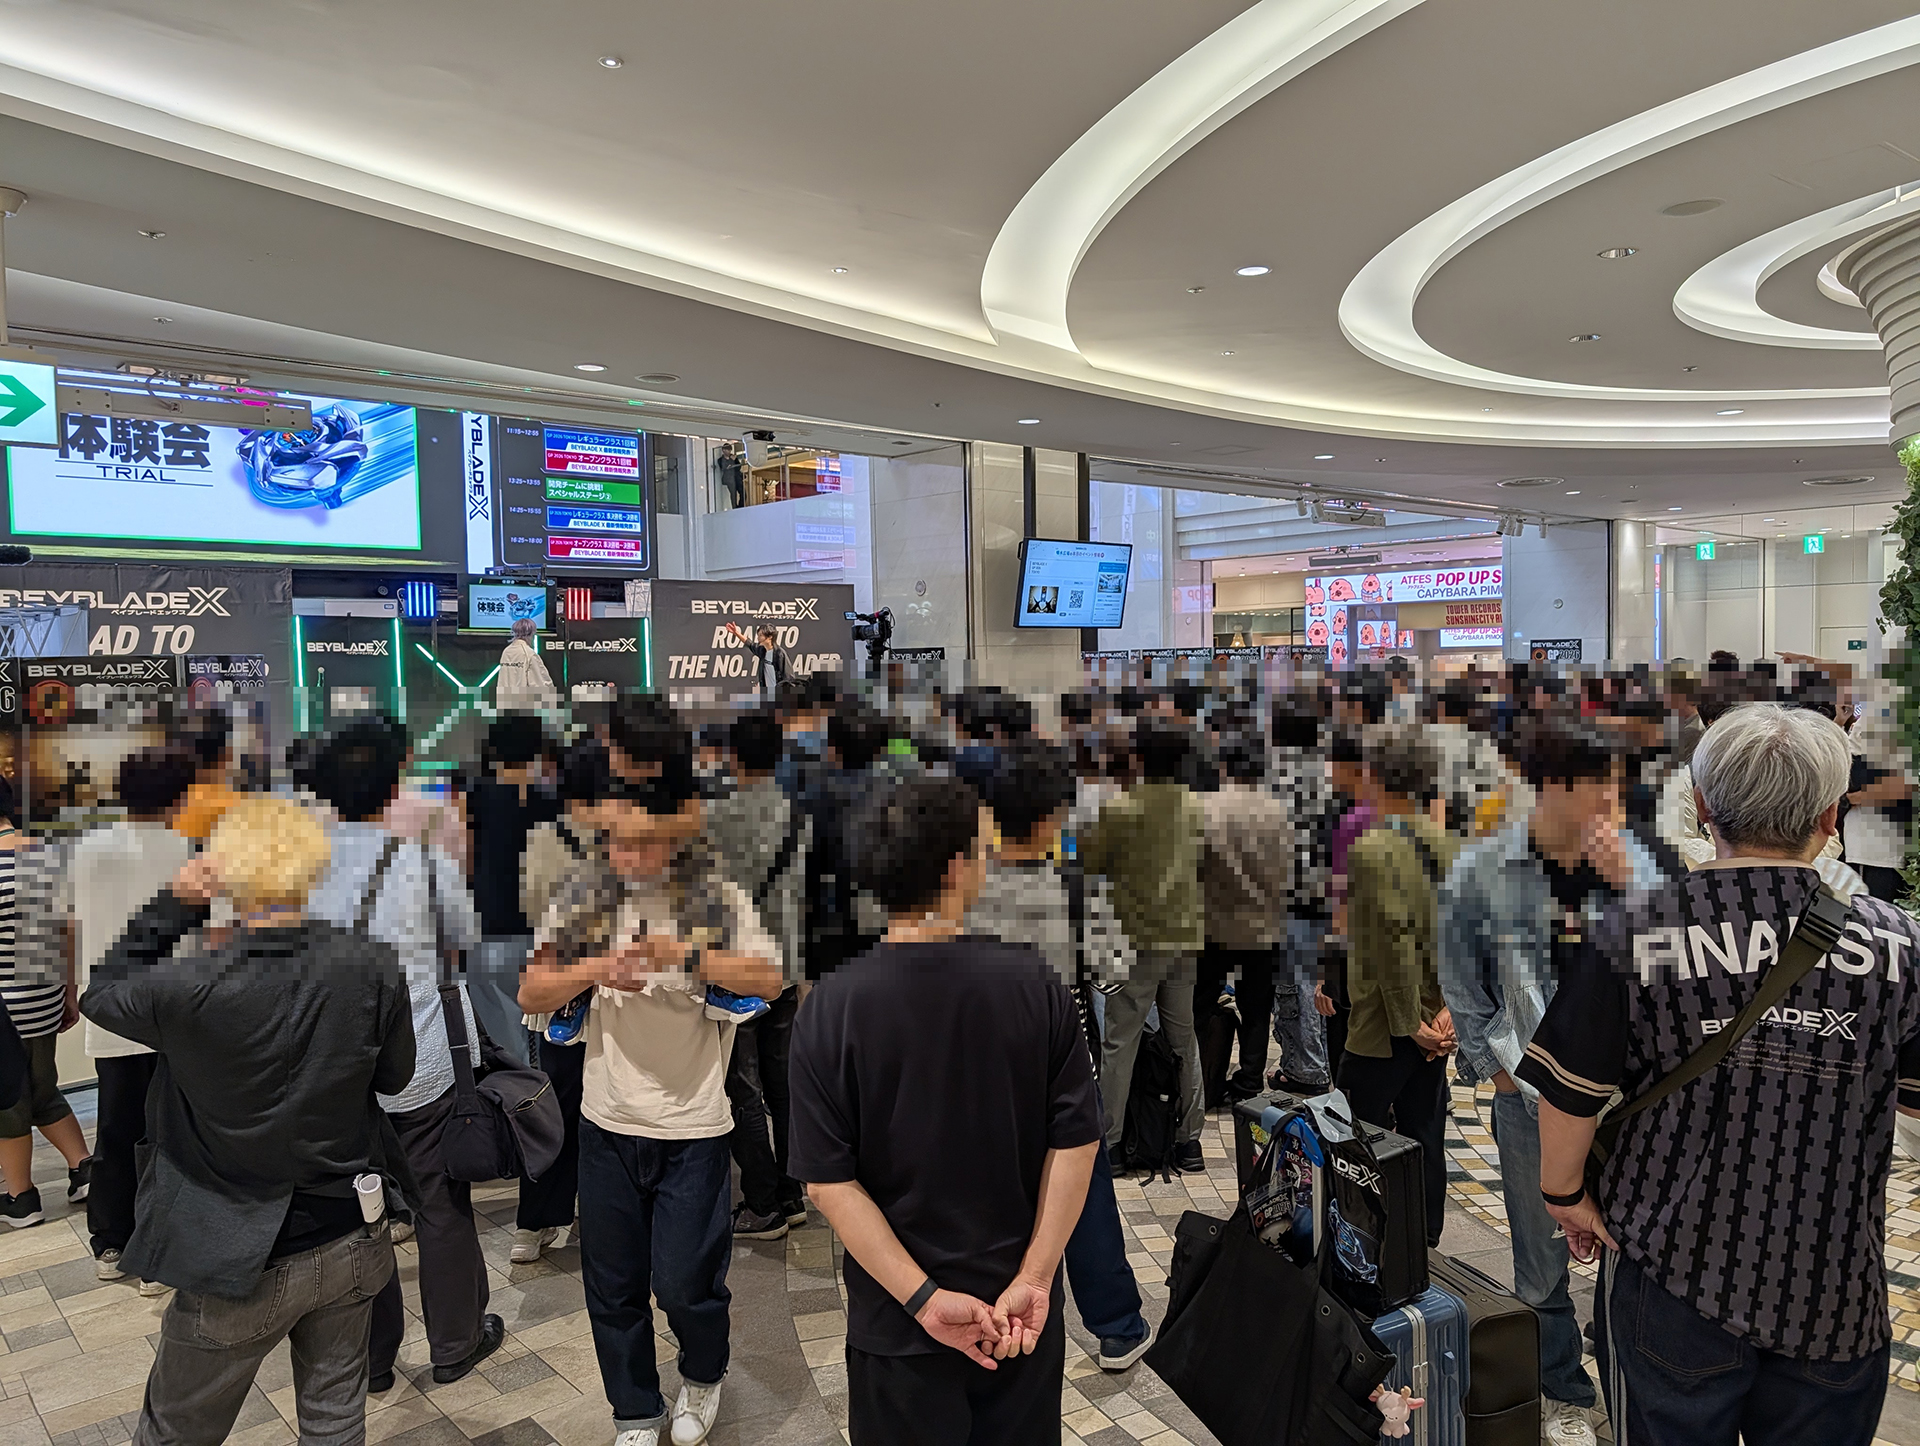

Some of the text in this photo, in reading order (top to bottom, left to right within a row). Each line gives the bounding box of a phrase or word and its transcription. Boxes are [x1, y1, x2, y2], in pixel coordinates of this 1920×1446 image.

[59, 413, 211, 468] 体験会
[96, 466, 176, 482] TRIAL
[1400, 574, 1432, 585] ATFES
[1435, 572, 1465, 587] POP
[1468, 570, 1490, 585] UP
[1417, 585, 1502, 599] CAPYBARA PIM
[477, 602, 505, 613] 体験会
[691, 598, 820, 621] BEYBLADEX
[1446, 603, 1501, 615] TOWER RECORDS
[151, 624, 196, 656] TO
[712, 625, 800, 649] ROA TO
[307, 640, 389, 656] BEYBLADEX
[27, 659, 171, 679] BEYBLADEX
[189, 658, 263, 677] BEYBLADEX
[668, 655, 710, 679] THE
[712, 655, 759, 679] NO.1
[1633, 916, 1912, 986] FINAST
